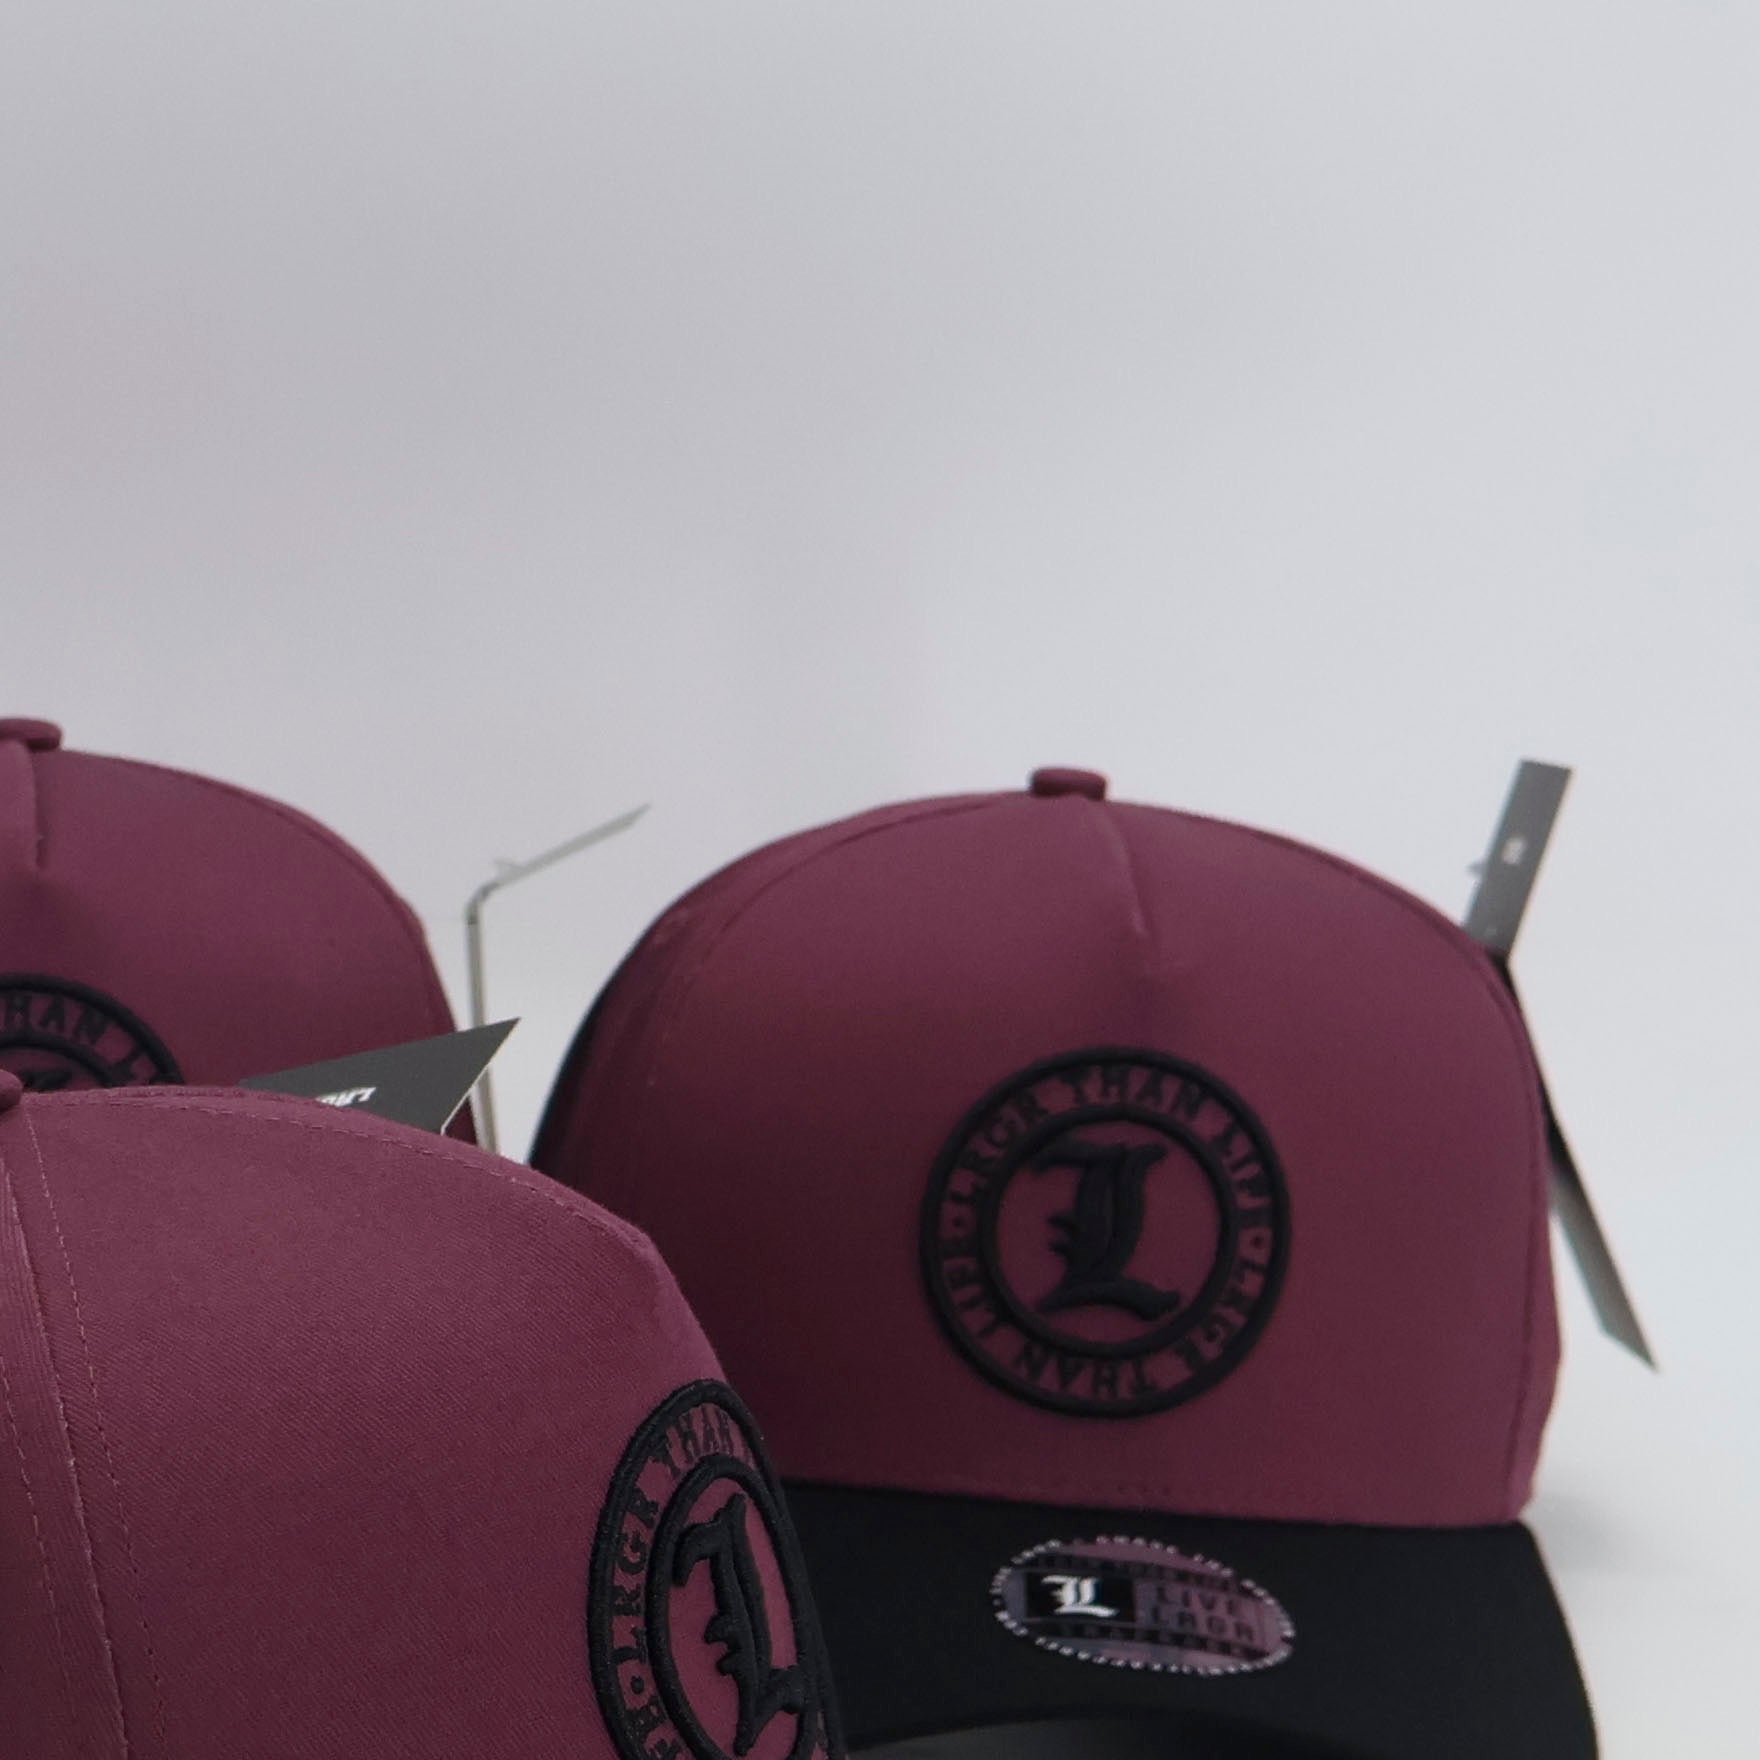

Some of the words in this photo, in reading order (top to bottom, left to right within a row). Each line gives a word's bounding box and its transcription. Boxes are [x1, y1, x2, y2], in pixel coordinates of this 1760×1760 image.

[951, 1087, 1047, 1204] LRGR
[1058, 1065, 1201, 1117] THAN
[1208, 1124, 1272, 1228] LIFE
[1028, 1138, 1181, 1322] L
[1019, 1345, 1157, 1400] THAN
[612, 1487, 660, 1664] LRGR
[673, 1493, 807, 1757] L
[1041, 1574, 1121, 1619] L
